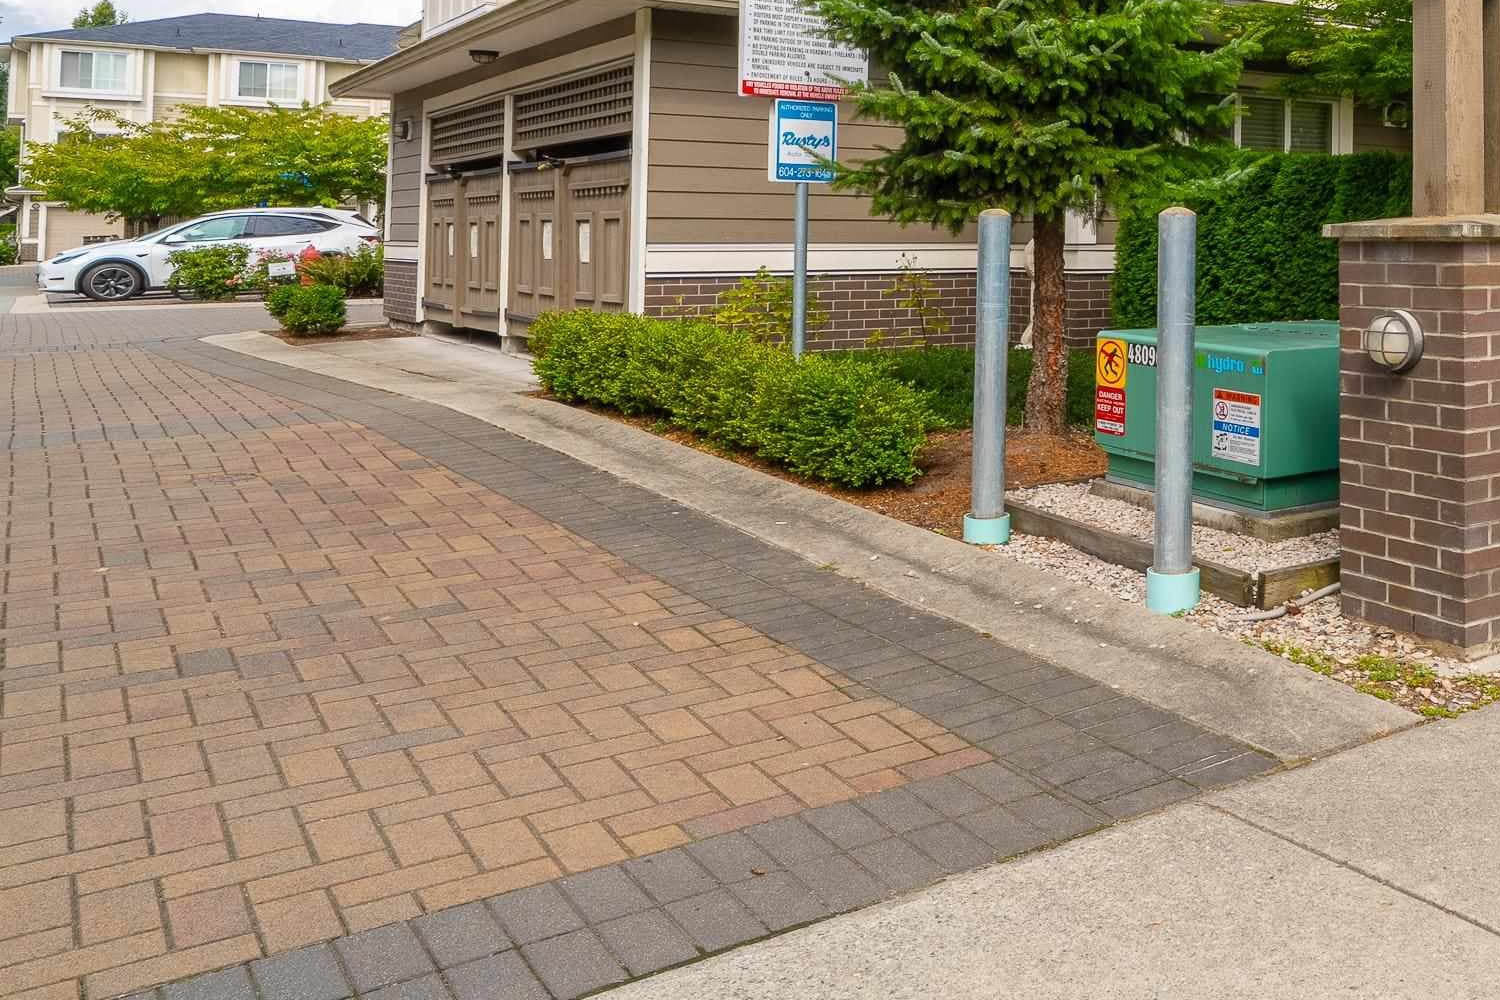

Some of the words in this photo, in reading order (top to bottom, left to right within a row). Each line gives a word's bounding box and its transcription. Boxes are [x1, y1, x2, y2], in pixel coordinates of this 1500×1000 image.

[780, 104, 811, 112] AUTHORIZED
[1128, 343, 1158, 367] 4809
[1207, 354, 1244, 374] hydro
[1098, 390, 1122, 401] DANGER
[1097, 403, 1112, 412] KEEP
[1112, 406, 1124, 415] OUT
[1222, 422, 1250, 435] NOTICE
